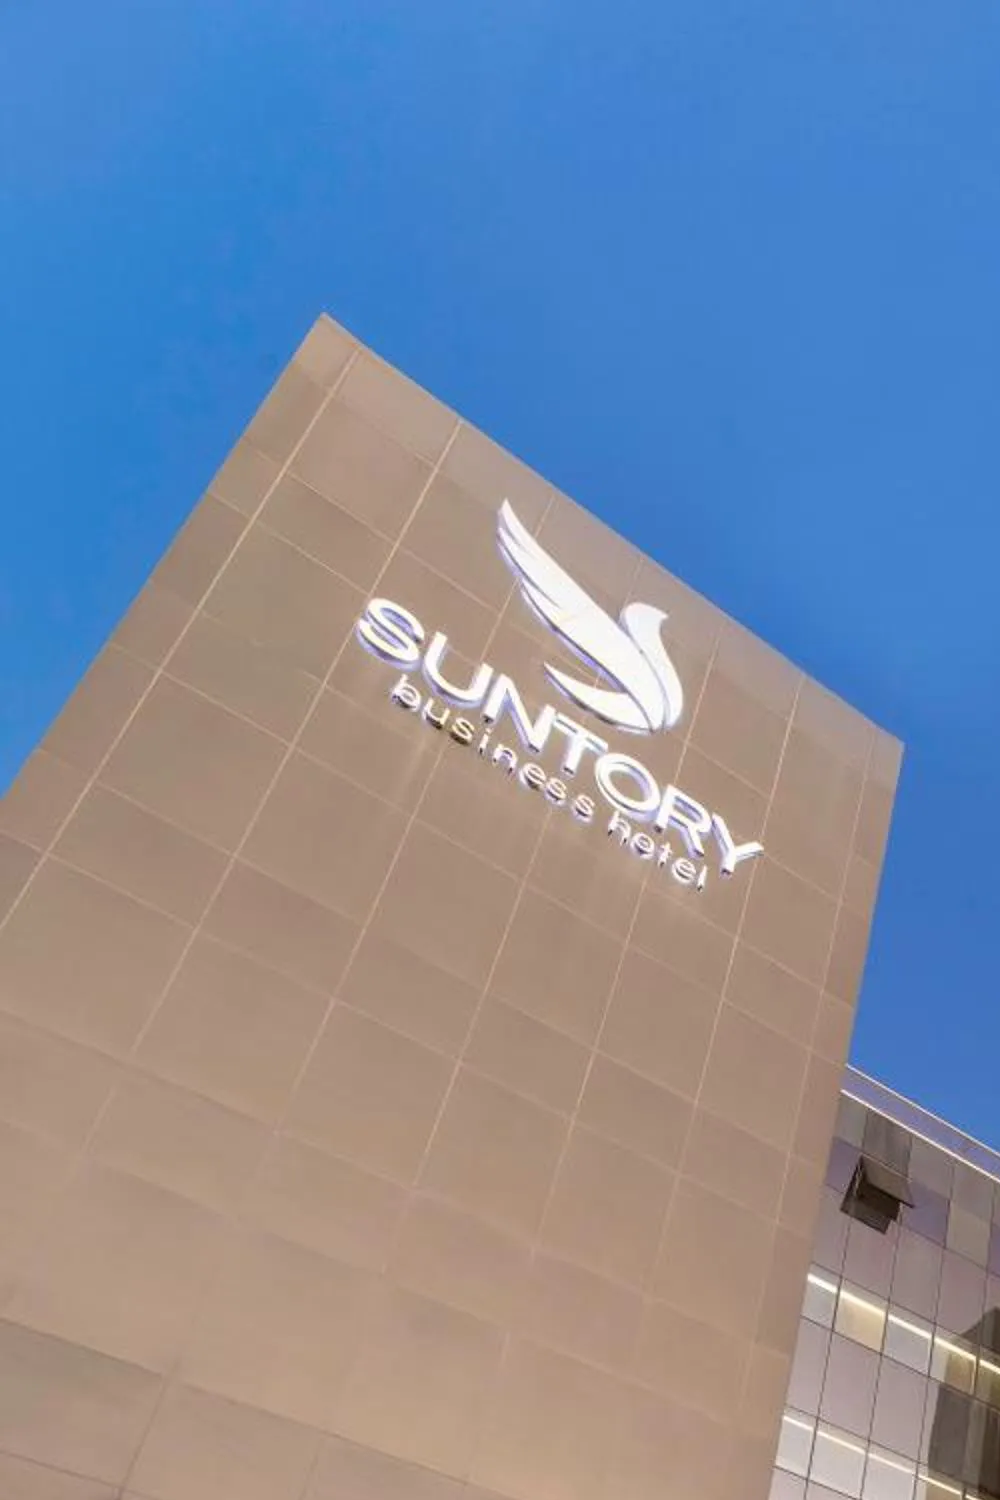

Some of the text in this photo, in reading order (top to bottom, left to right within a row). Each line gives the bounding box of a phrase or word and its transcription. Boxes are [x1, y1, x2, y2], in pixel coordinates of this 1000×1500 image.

[356, 598, 764, 876] SUNTORY
[391, 674, 707, 891] business hotel
